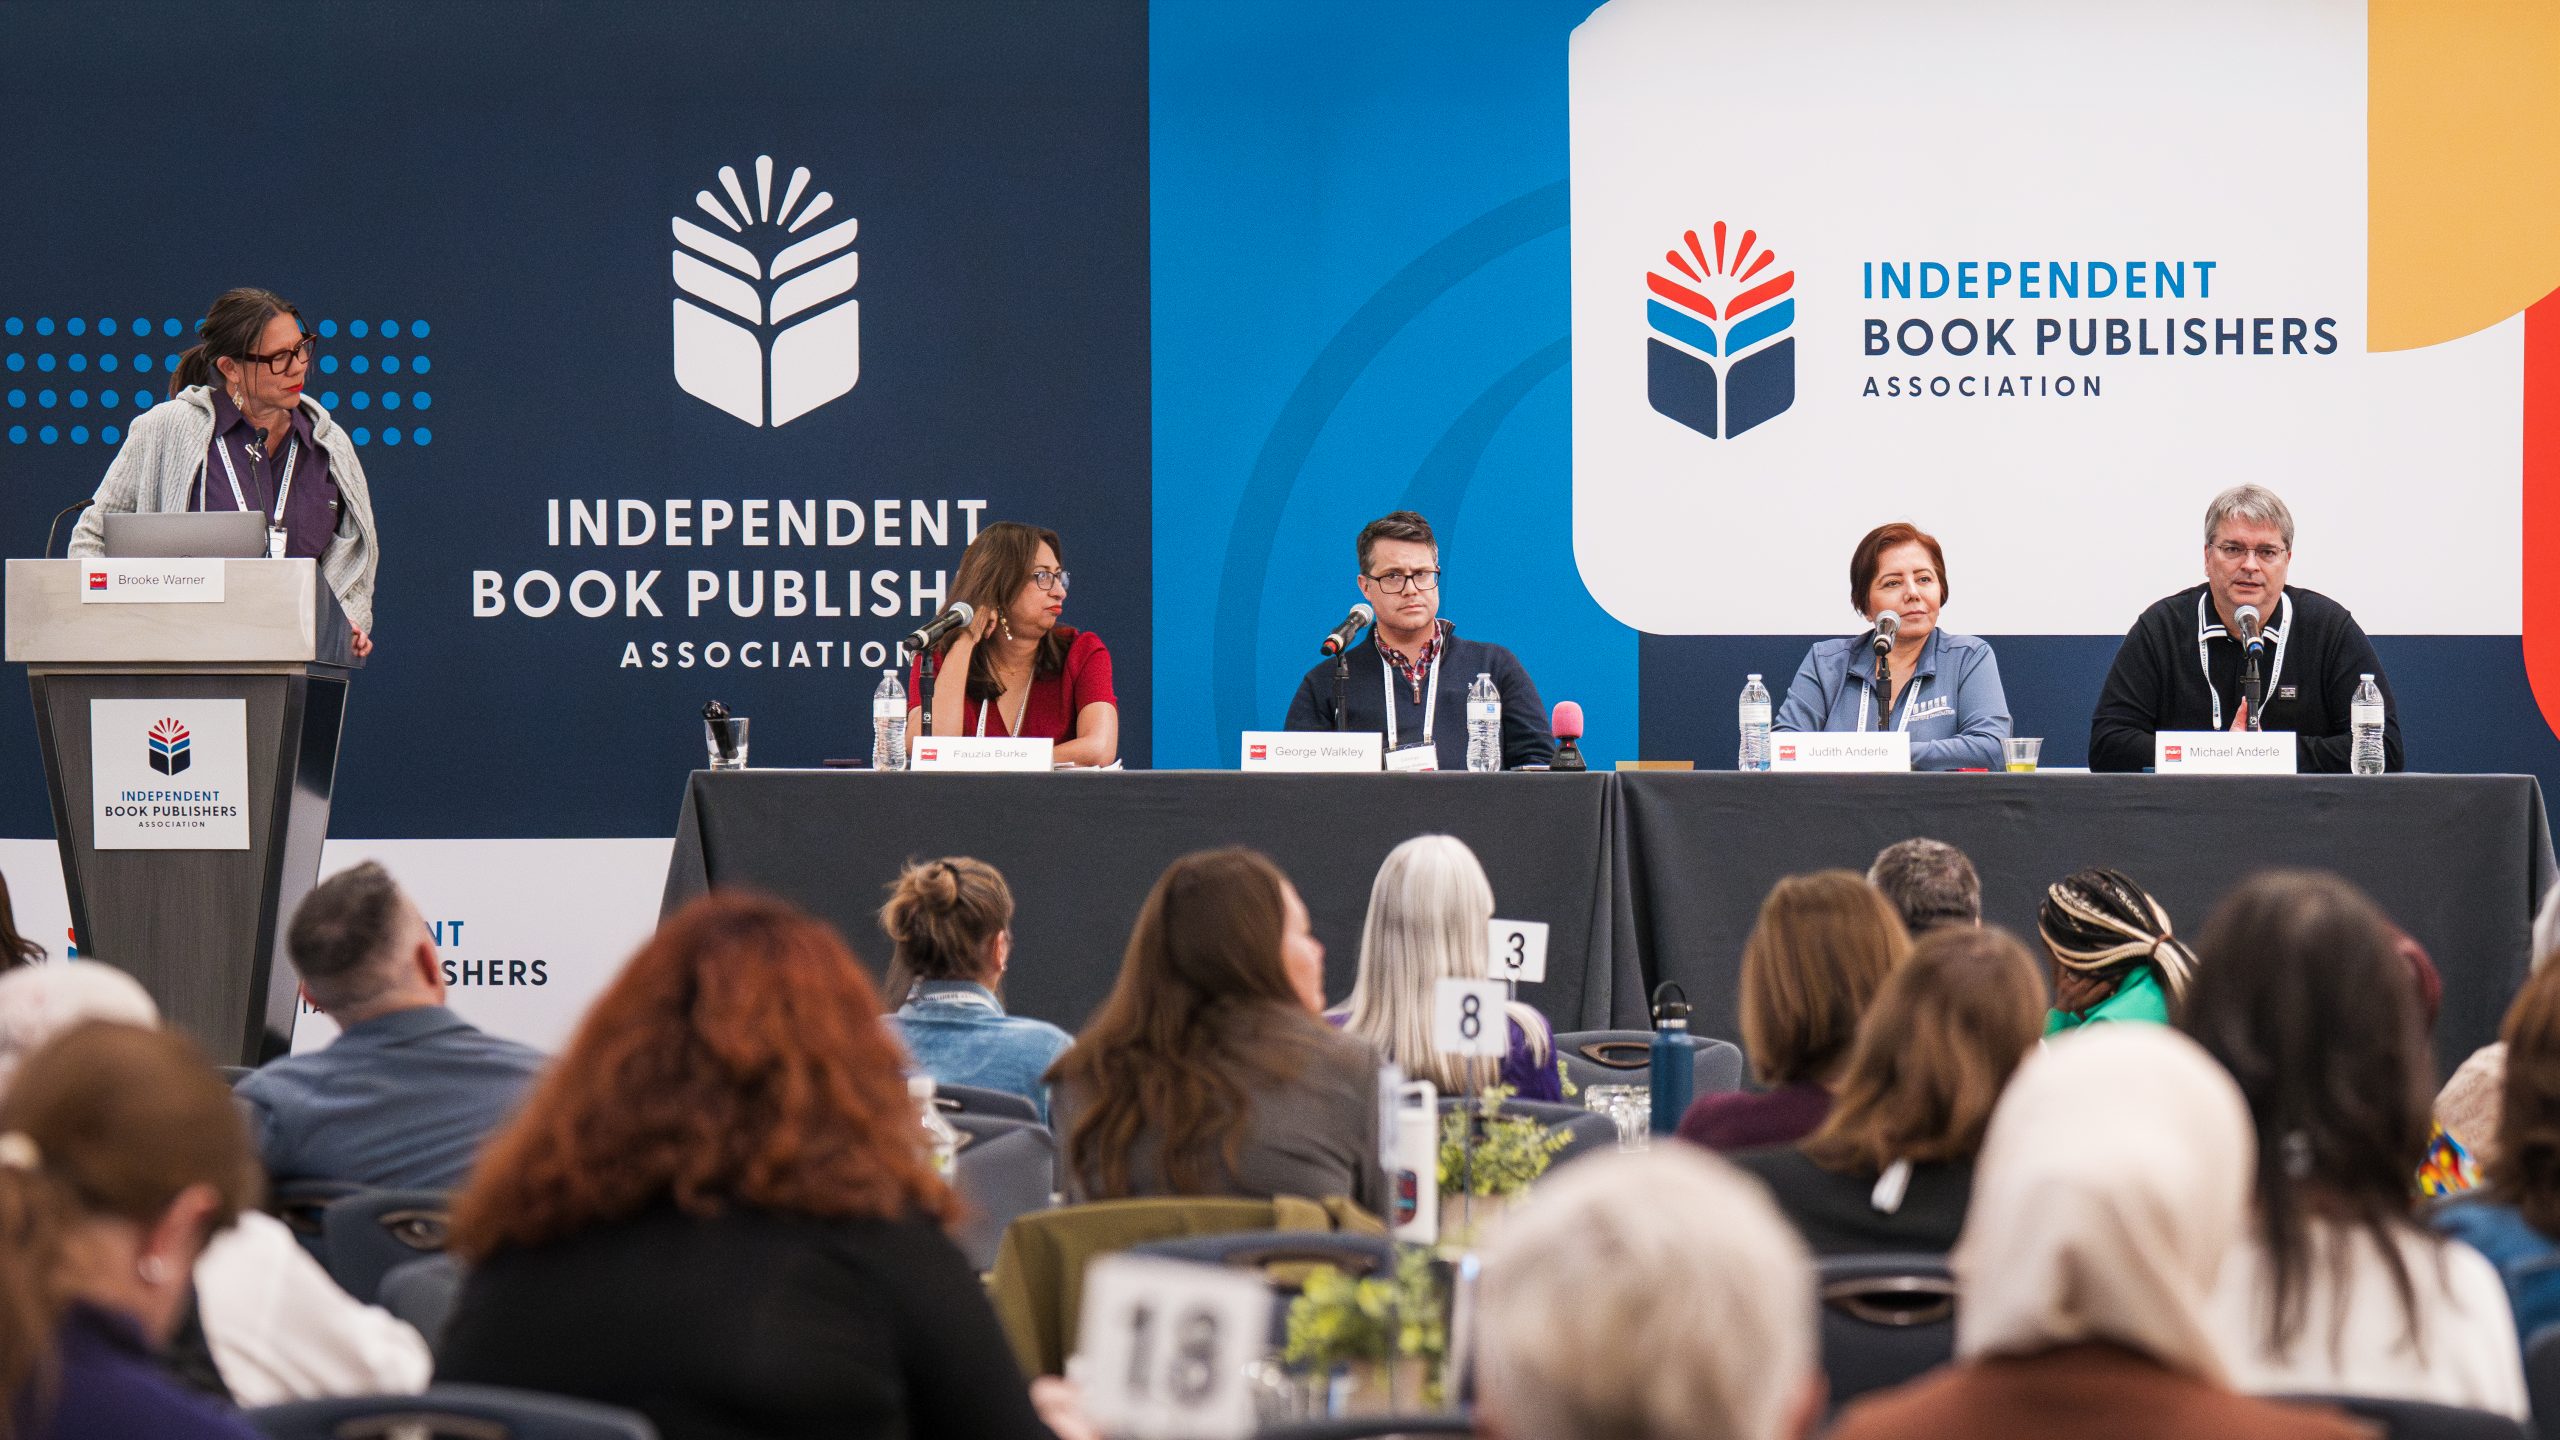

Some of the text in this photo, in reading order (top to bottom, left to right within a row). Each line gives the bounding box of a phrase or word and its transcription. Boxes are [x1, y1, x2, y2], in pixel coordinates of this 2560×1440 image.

[1863, 261, 2217, 299] INDEPENDENT
[1864, 316, 2338, 357] BOOK PUBLISHERS
[1862, 375, 2101, 398] ASSOCIATION
[547, 498, 988, 546] INDEPENDENT
[118, 574, 160, 585] Brooke
[163, 574, 205, 585] Warner
[472, 569, 948, 618] BOOK PUBLISH
[953, 750, 1028, 758] Fauzia Burke
[1275, 746, 1317, 759] George
[1320, 746, 1364, 759] Walkley
[1808, 746, 1842, 757] Judith
[1845, 746, 1889, 757] Anderle
[2190, 746, 2233, 757] Michael
[2236, 746, 2280, 757] Anderle
[121, 790, 220, 802] INDEPENDENT
[105, 805, 237, 817] BOOK PUBLISHERS
[1505, 932, 1525, 969] 3
[441, 959, 548, 987] SHERS
[1460, 993, 1481, 1040] 8
[1126, 1302, 1221, 1409] 18
